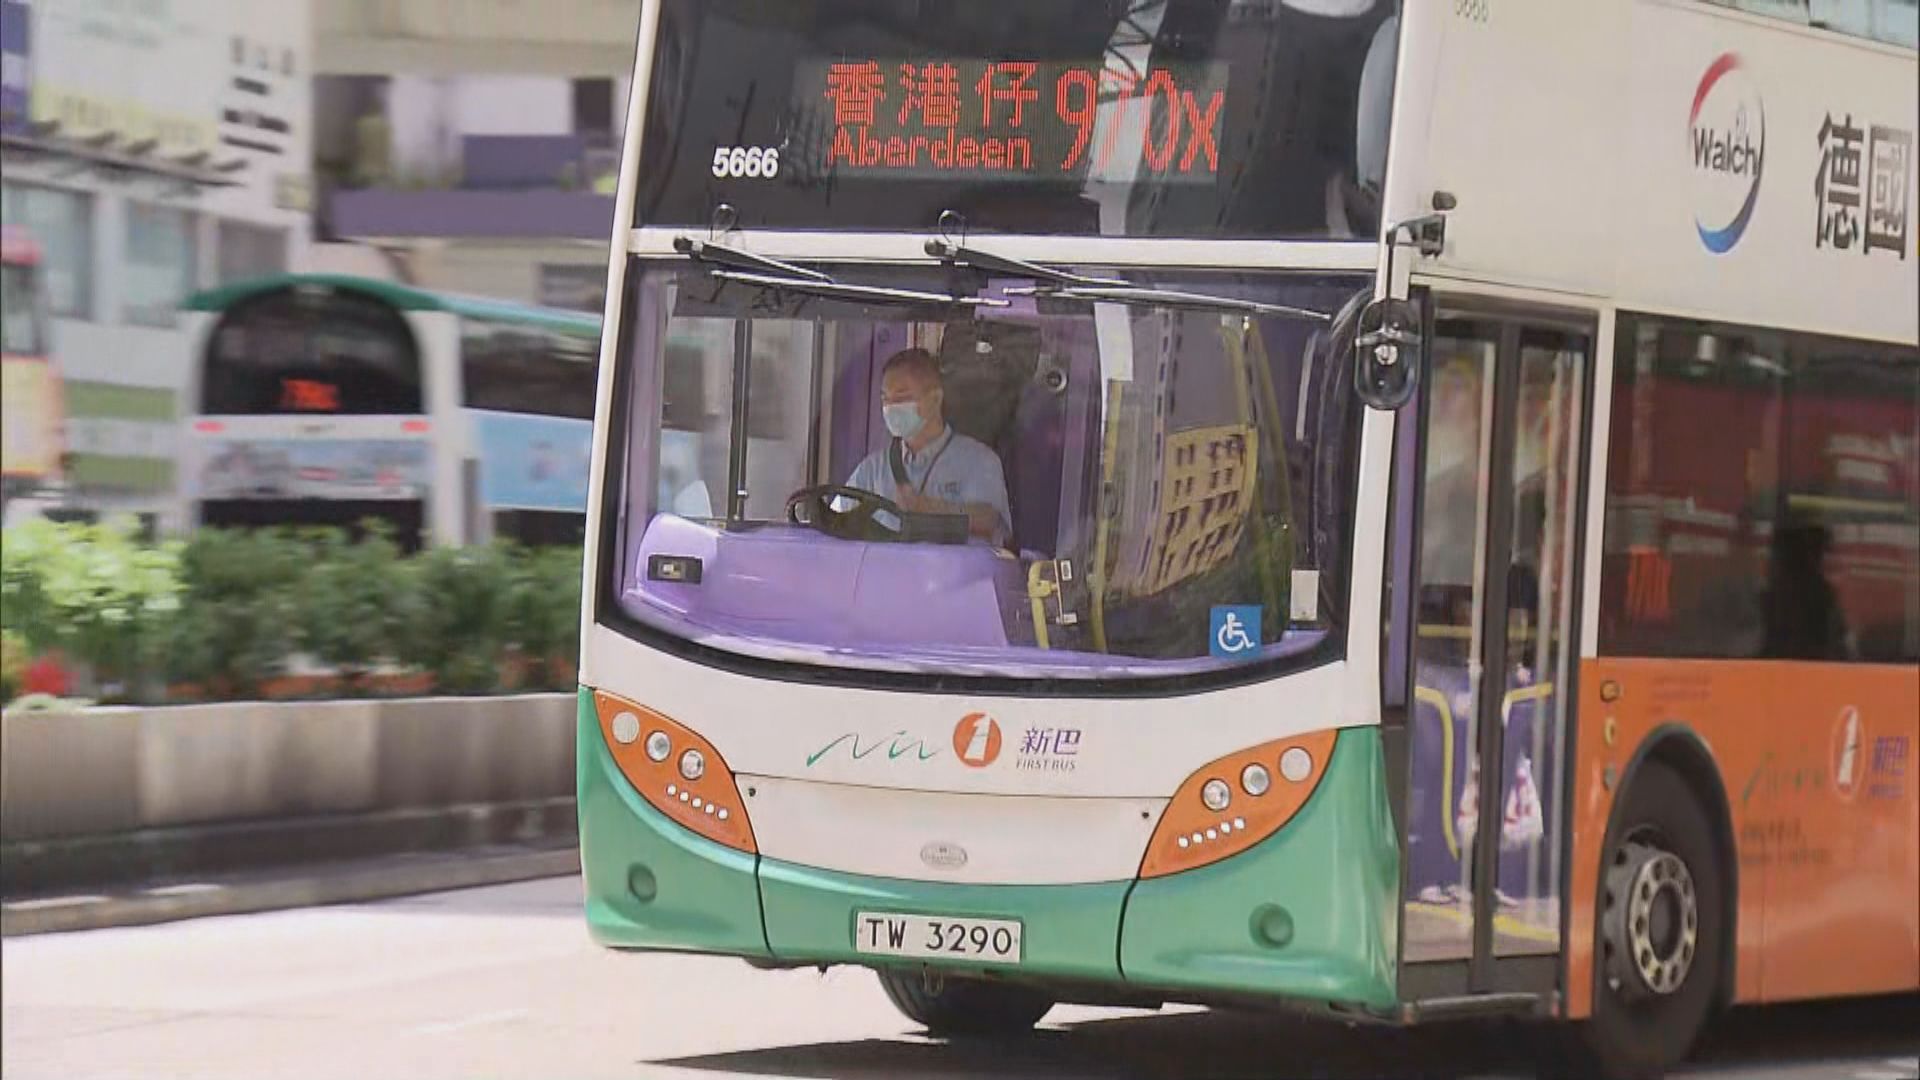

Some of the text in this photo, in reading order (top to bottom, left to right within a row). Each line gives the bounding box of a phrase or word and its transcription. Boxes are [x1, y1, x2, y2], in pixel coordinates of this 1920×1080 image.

[823, 60, 1039, 129] 香港仔
[1055, 67, 1224, 173] 970X
[711, 146, 779, 179] 5666
[827, 126, 1033, 170] Aberdeen
[1694, 127, 1759, 177] Walch
[1814, 112, 1912, 260] 德國
[1019, 726, 1082, 756] 新巴
[1015, 759, 1076, 770] FIRST BUS
[865, 918, 1013, 955] TW 3290
